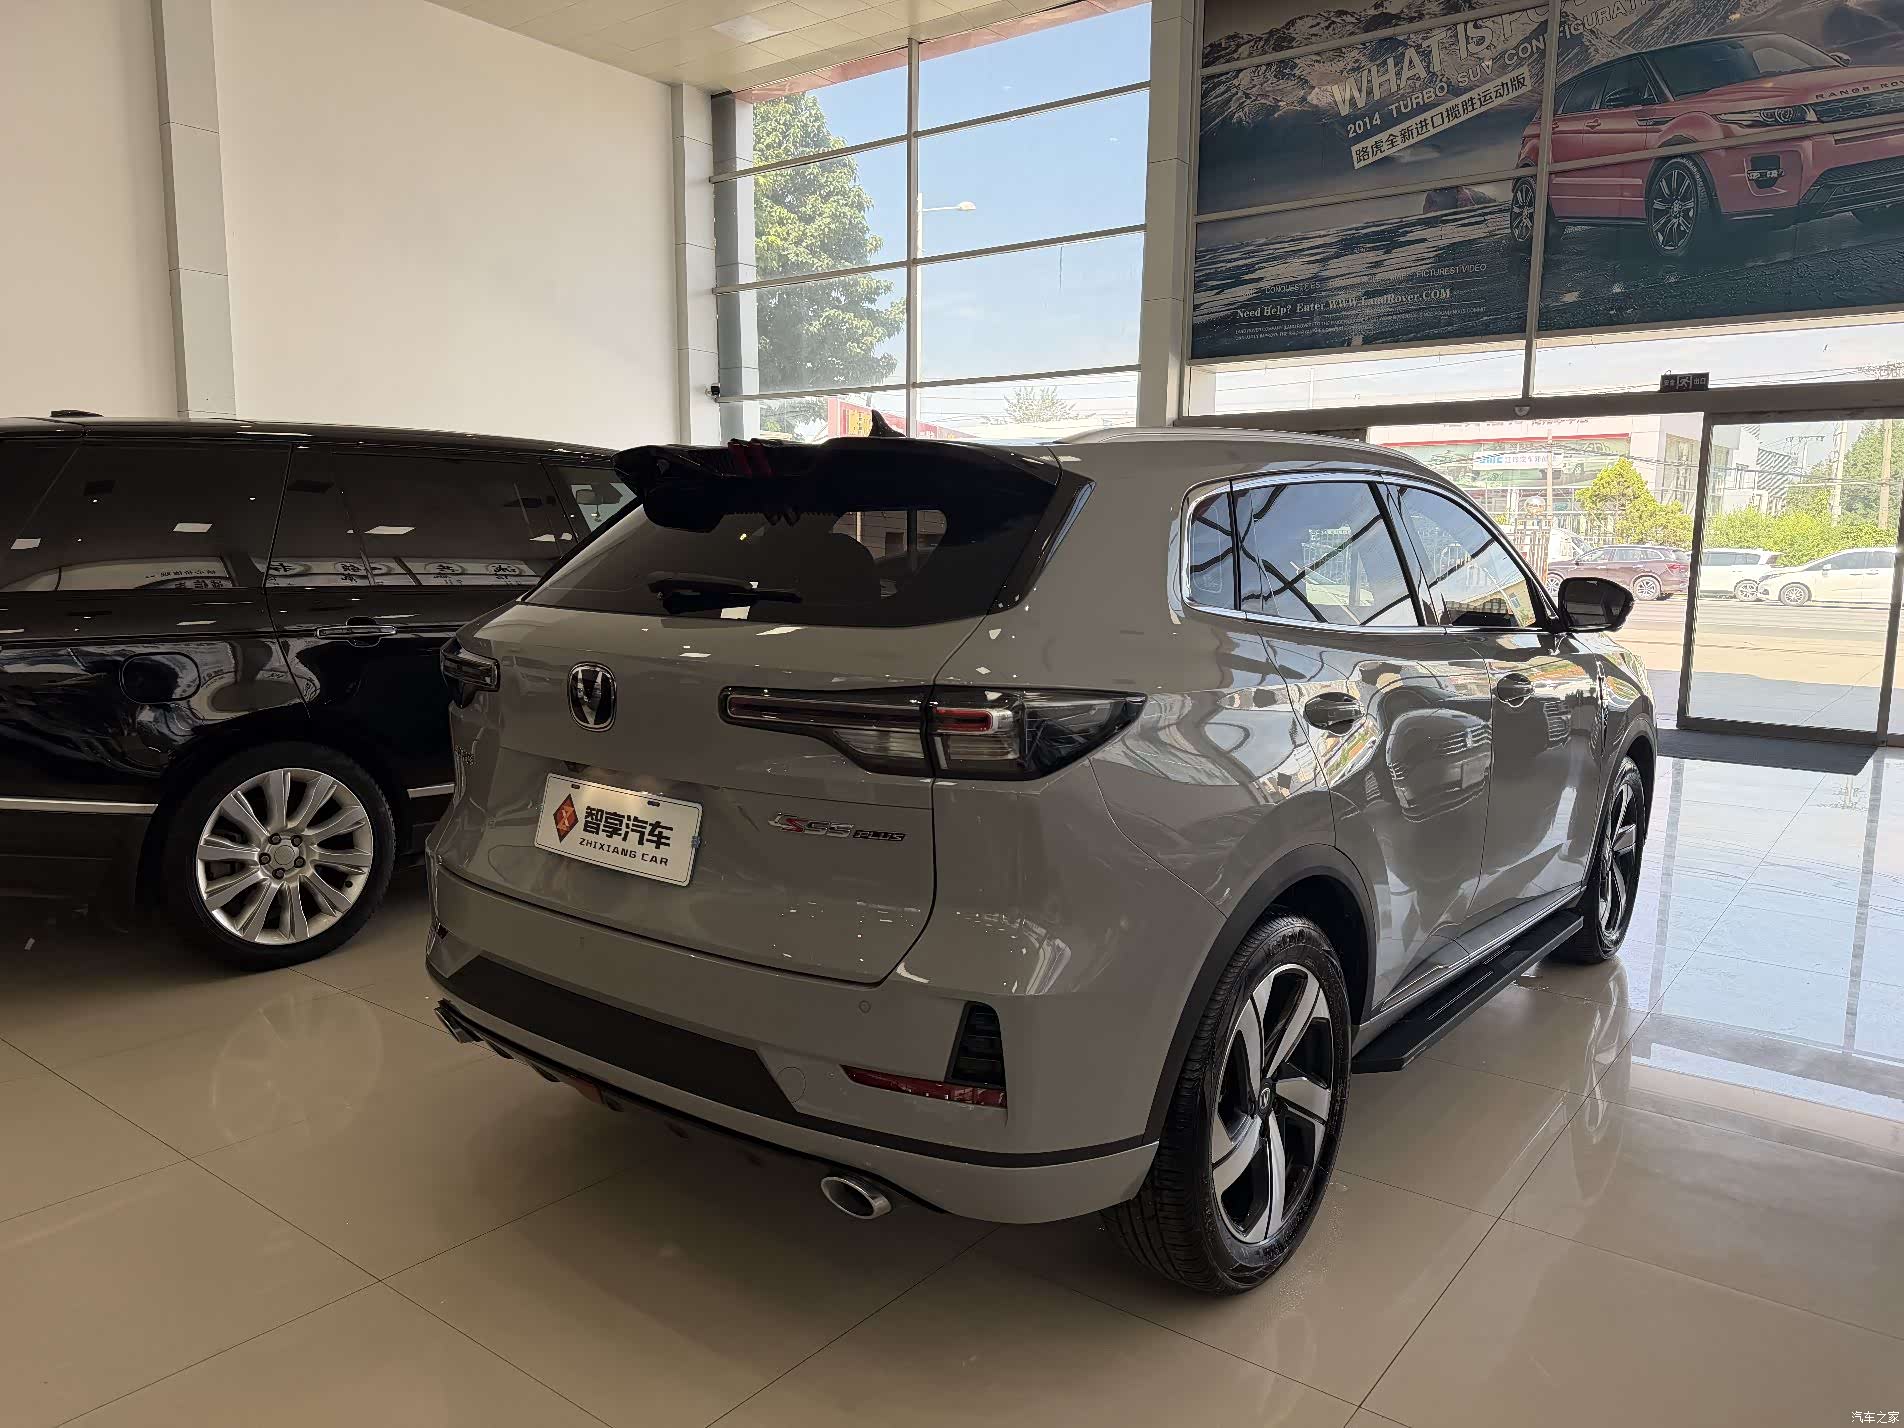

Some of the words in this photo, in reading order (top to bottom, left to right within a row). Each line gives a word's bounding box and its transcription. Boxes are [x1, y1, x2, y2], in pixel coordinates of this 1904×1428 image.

[1332, 27, 1450, 117] WHAT
[1457, 19, 1495, 62] IS
[1347, 112, 1381, 138] 2014
[1388, 83, 1448, 115] TURBO
[1458, 58, 1493, 86] SUV
[1815, 86, 1870, 100] RANGE
[1355, 72, 1528, 163] 路虎全新进口揽胜运动版
[1236, 308, 1261, 319] Need
[1263, 305, 1292, 317] Help?
[1296, 302, 1325, 313] Enter
[582, 806, 674, 850] 智享汽车
[579, 837, 637, 859] ZHIXIANG
[641, 852, 669, 867] CAR
